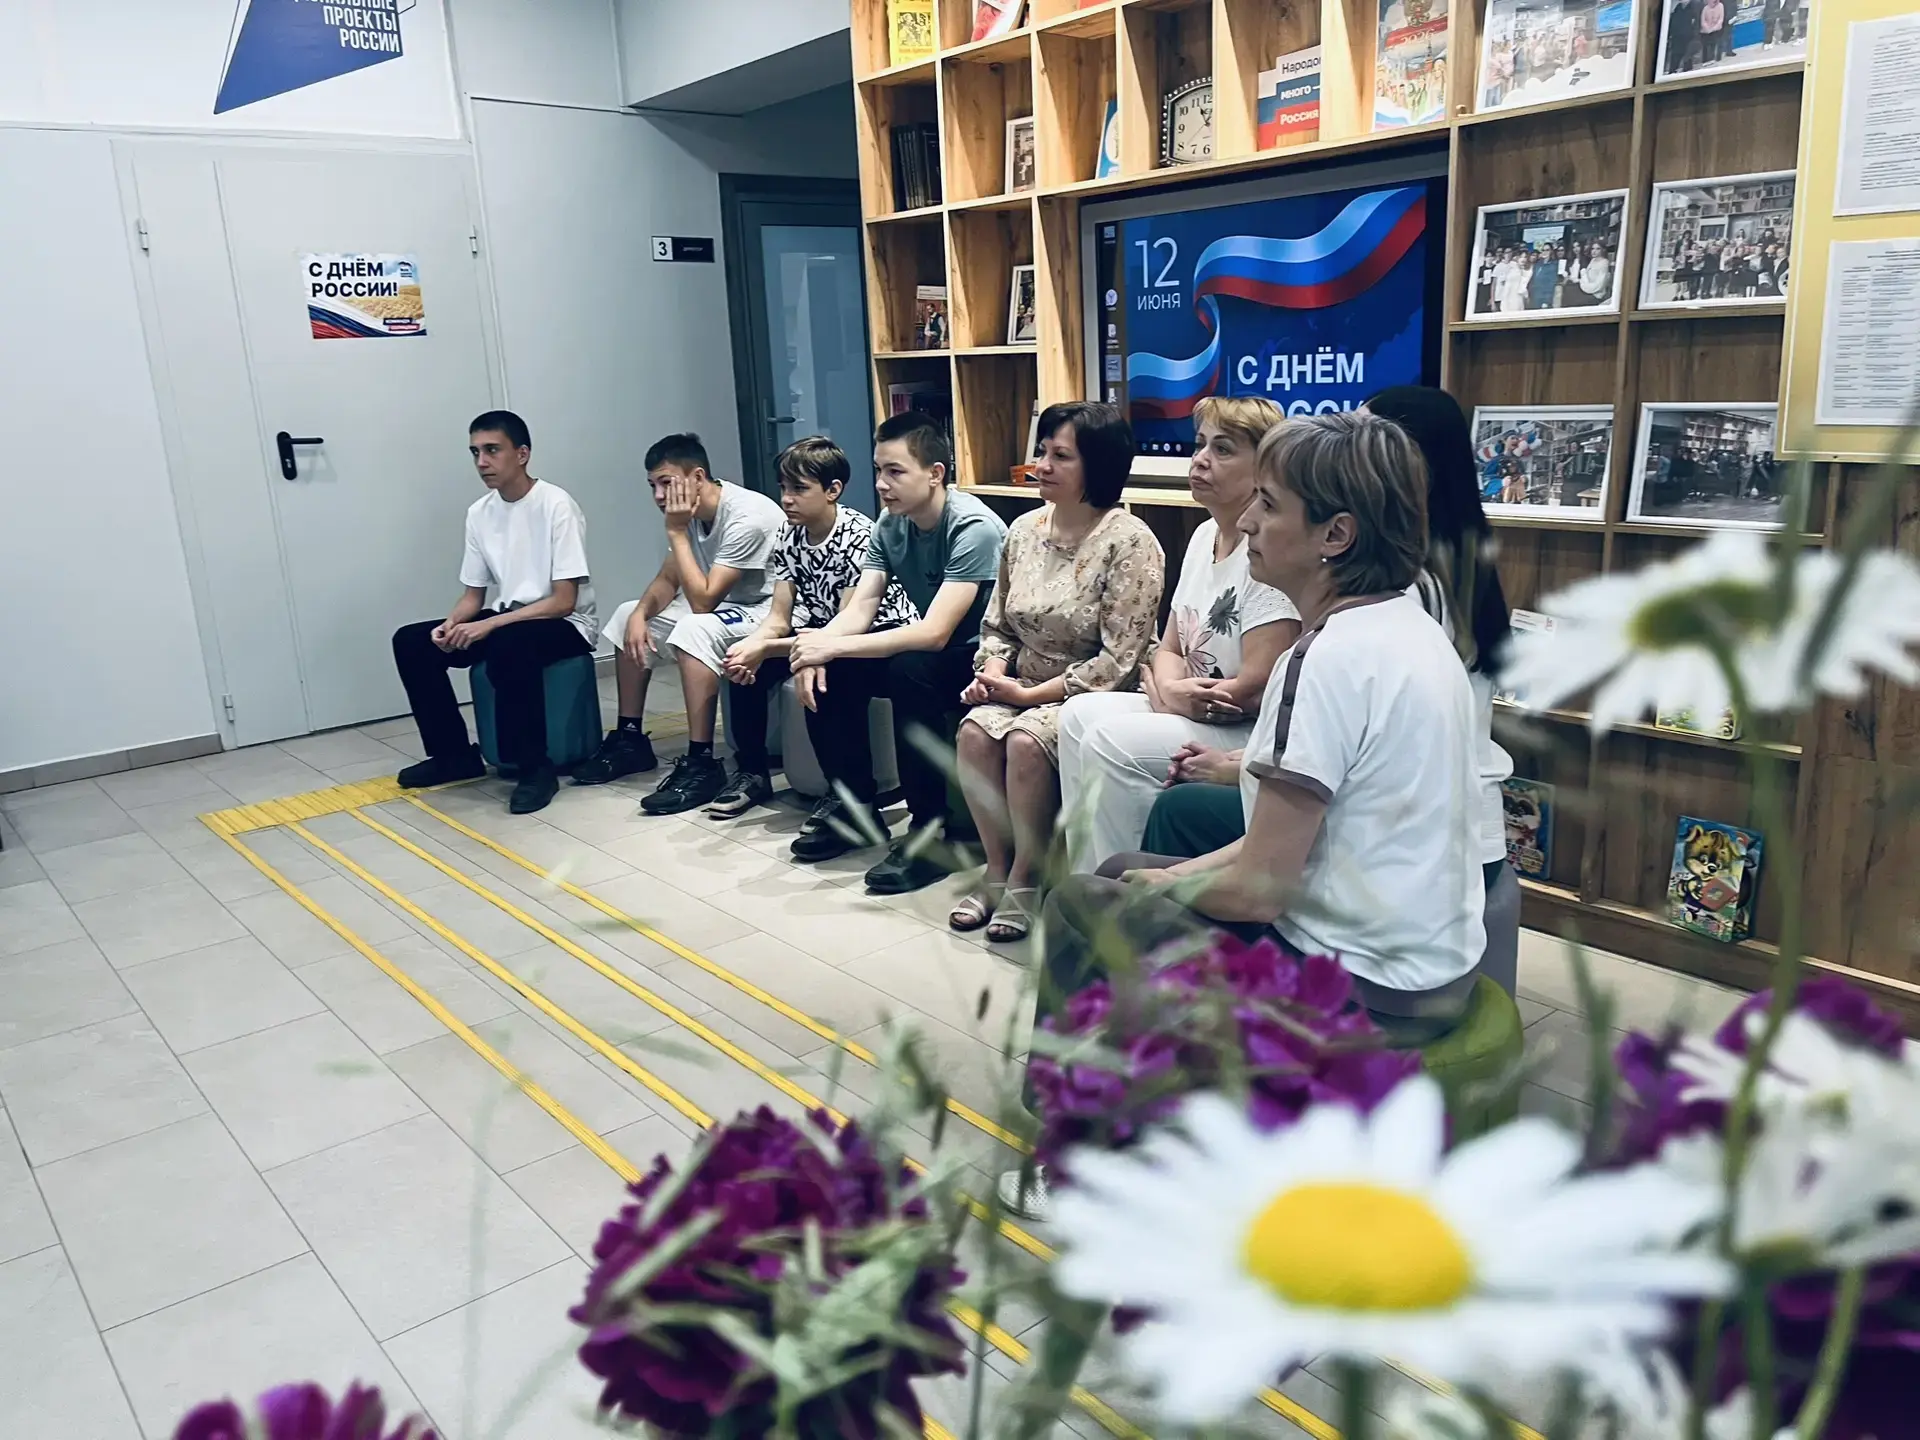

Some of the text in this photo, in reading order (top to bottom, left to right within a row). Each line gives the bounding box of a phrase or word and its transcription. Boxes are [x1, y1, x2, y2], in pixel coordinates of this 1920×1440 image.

[323, 5, 398, 31] ПРОЕКТЫ
[339, 28, 400, 52] РОССИИ
[1281, 85, 1311, 100] много
[1191, 97, 1200, 108] 11
[1280, 109, 1319, 125] Россия
[1178, 123, 1185, 134] 9
[1190, 143, 1197, 155] 7
[1203, 144, 1211, 155] 6
[658, 241, 668, 256] 3
[309, 262, 323, 277] С
[327, 258, 384, 280] ДНЁМ
[1135, 237, 1180, 288] 12
[312, 282, 398, 297] РОССИИ!
[1137, 293, 1180, 310] ИЮНЯ
[1237, 346, 1364, 391] С ДНЁМ
